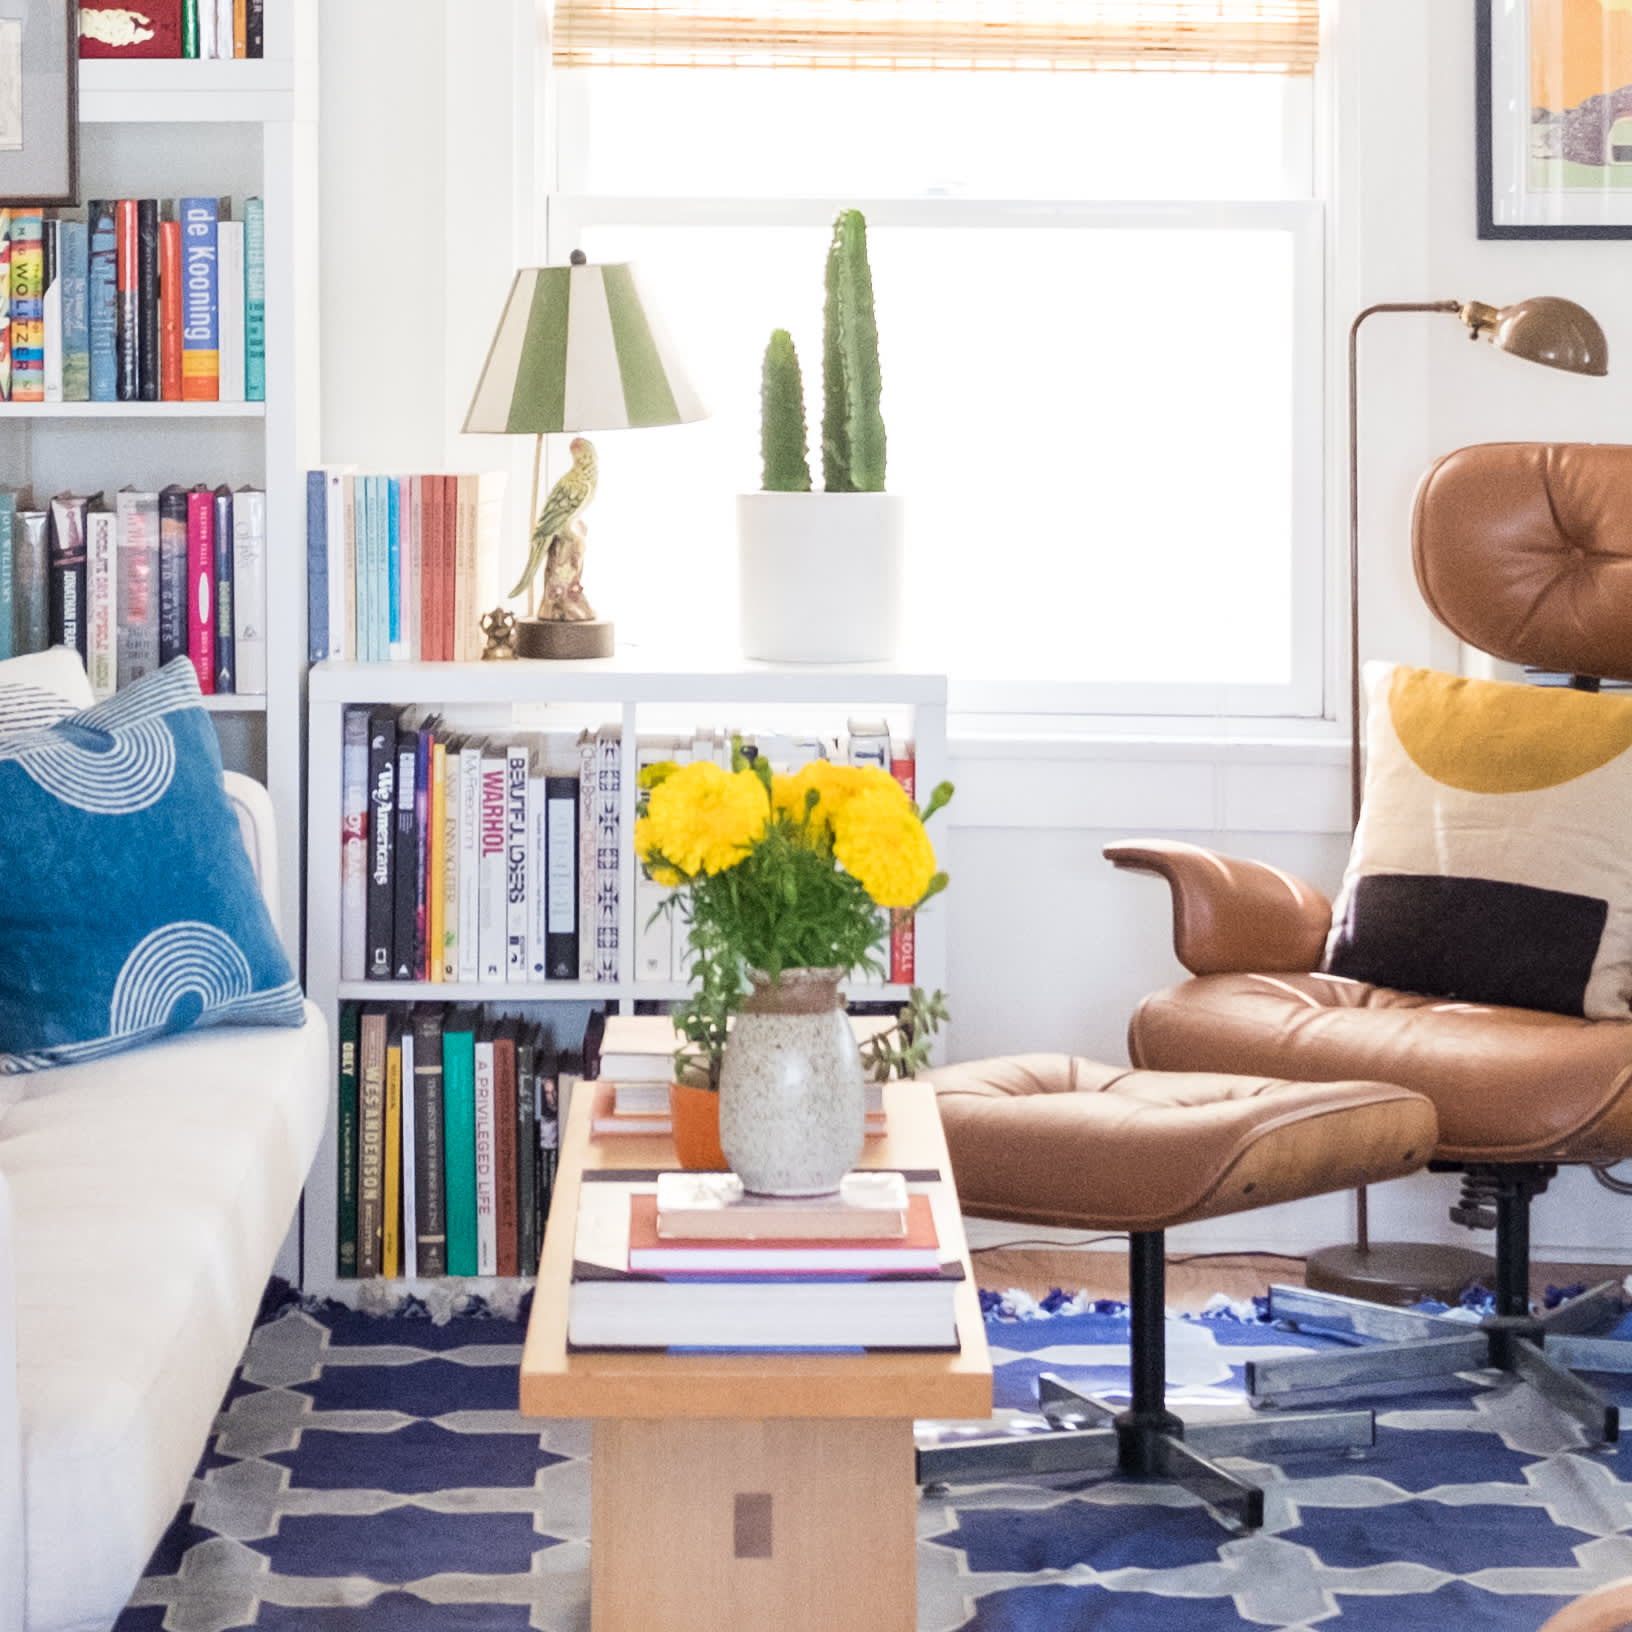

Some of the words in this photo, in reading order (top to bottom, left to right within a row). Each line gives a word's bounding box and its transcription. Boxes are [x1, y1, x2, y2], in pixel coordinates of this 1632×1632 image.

[187, 208, 216, 236] de
[15, 262, 30, 371] WOLITZER
[184, 245, 217, 341] Kooning
[63, 571, 77, 620] JONATHAN
[374, 761, 394, 801] We
[482, 770, 505, 859] WARHOL
[510, 757, 526, 840] BEAUTIFUL
[373, 800, 393, 885] Americans
[509, 844, 526, 904] LOSERS
[363, 1067, 380, 1106] WES
[477, 1059, 489, 1071] A
[363, 1109, 379, 1201] ANDERSON
[477, 1076, 491, 1176] PRIVILEGED
[478, 1181, 491, 1216] LIFE
